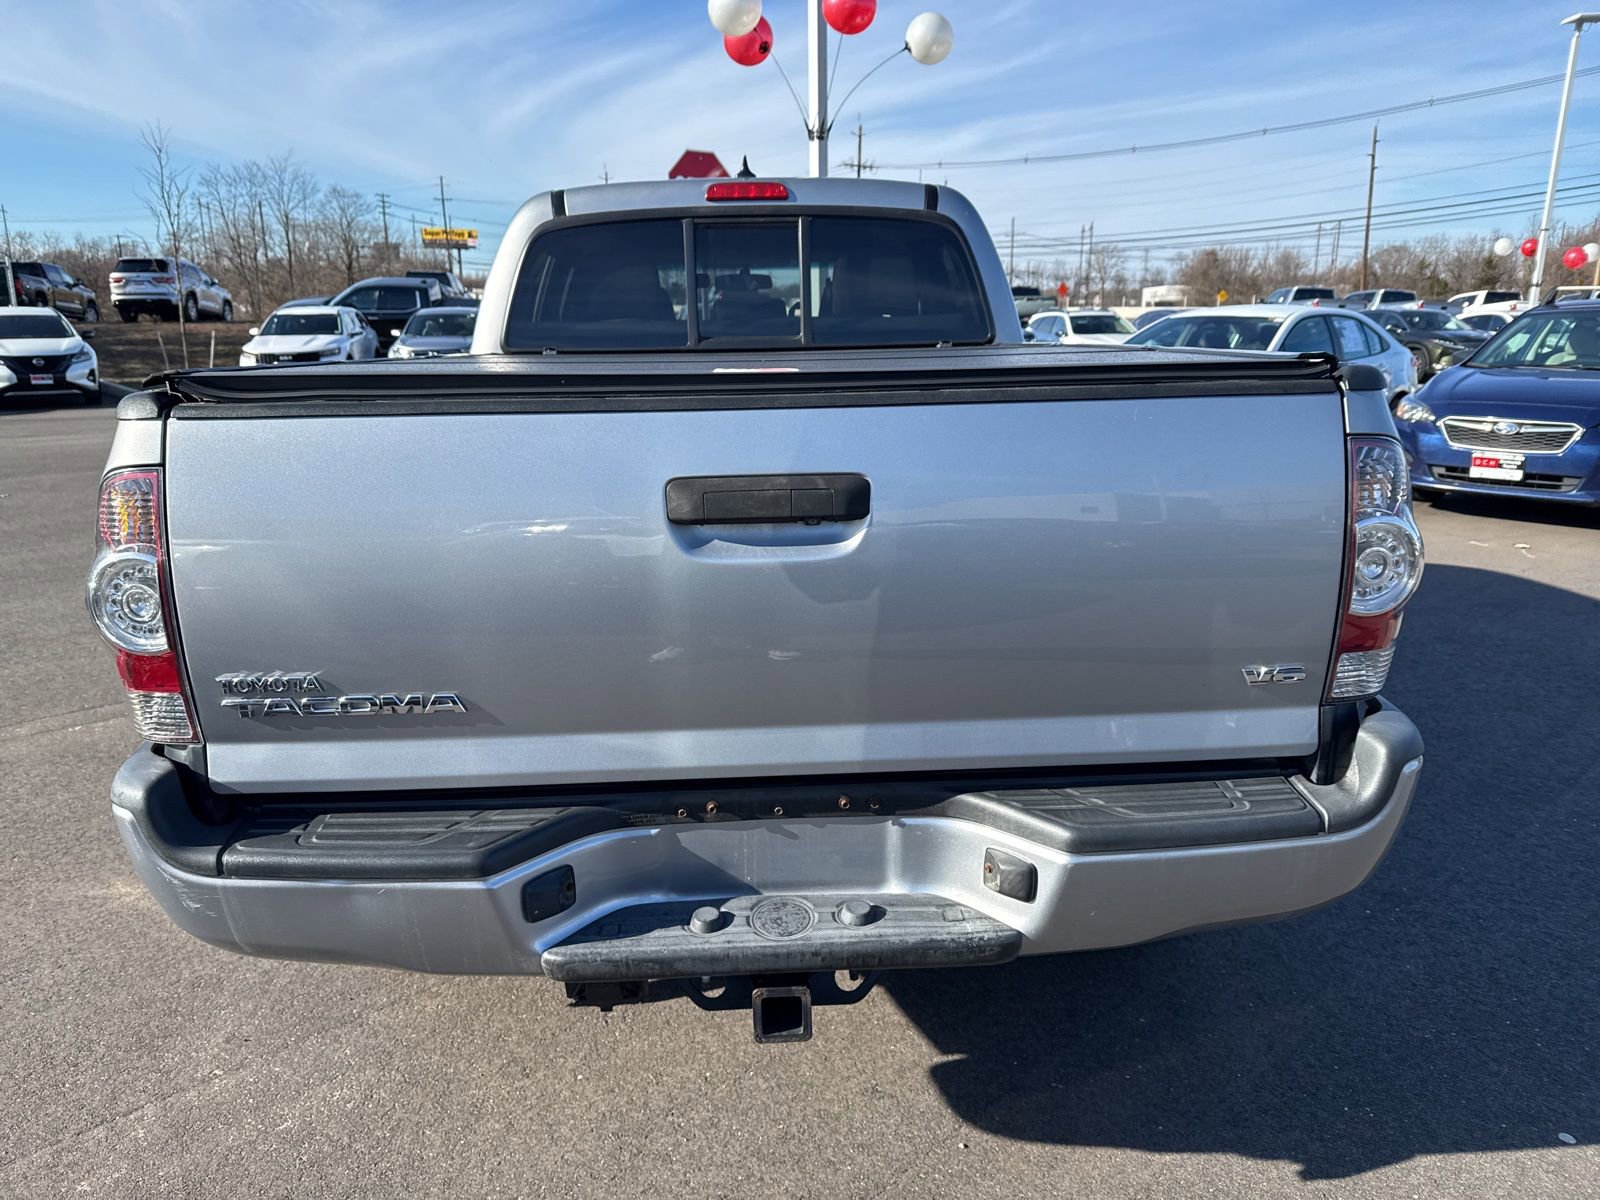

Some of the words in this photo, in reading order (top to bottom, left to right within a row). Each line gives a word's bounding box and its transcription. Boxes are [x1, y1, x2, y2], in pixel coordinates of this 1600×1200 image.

[215, 671, 325, 693] TOYOTA
[1241, 665, 1306, 685] V6
[221, 692, 469, 717] TACOMA
